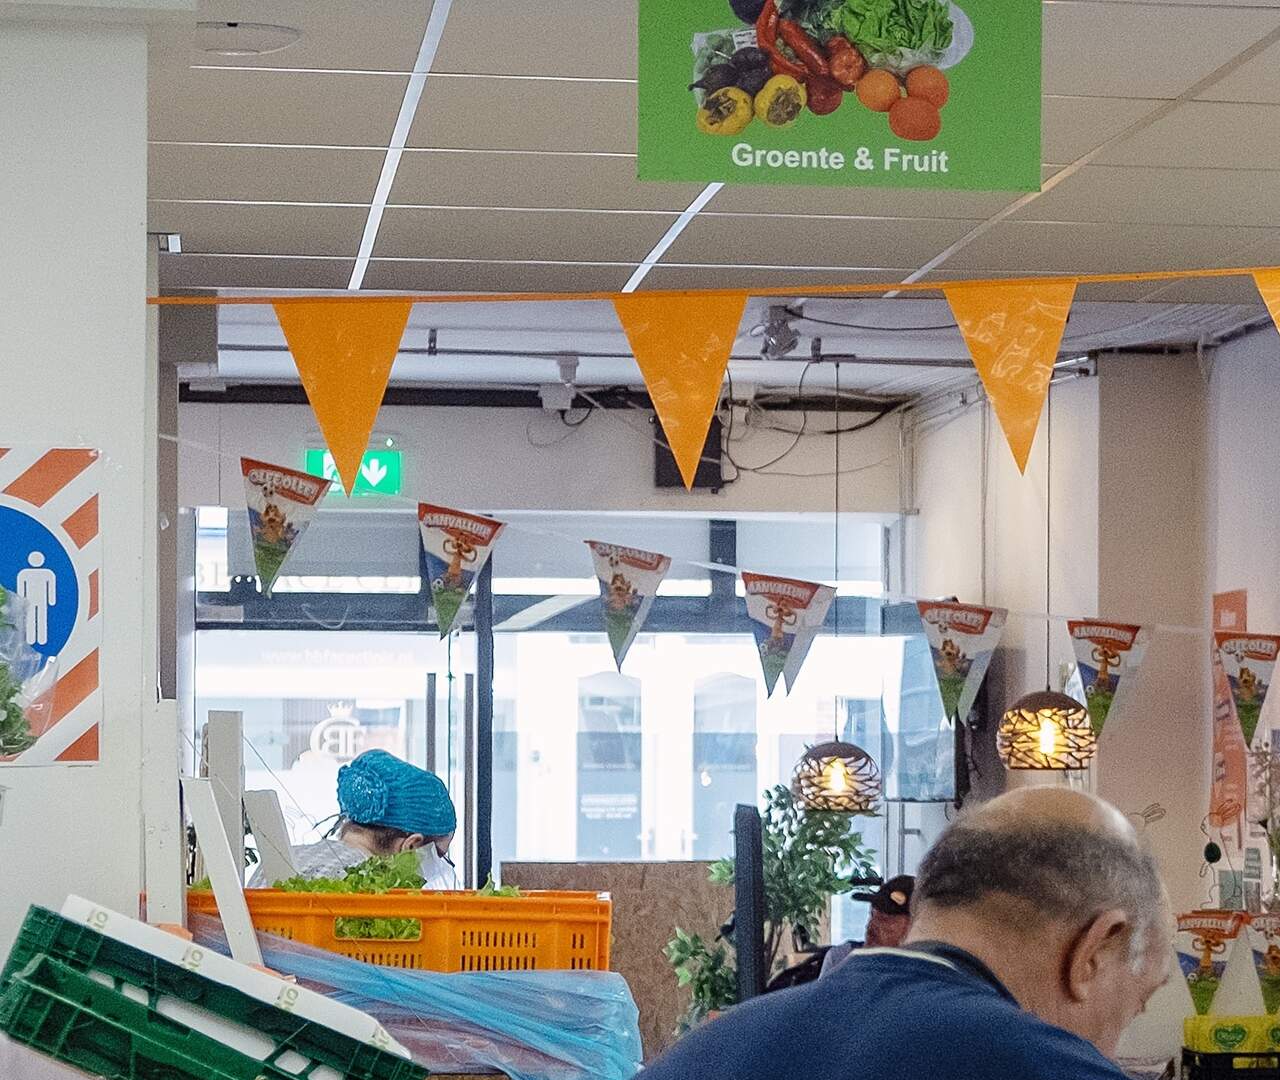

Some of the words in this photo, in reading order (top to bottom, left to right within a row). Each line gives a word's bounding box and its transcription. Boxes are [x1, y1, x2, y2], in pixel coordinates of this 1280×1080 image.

[731, 143, 845, 170] Groente
[854, 148, 874, 171] &
[884, 148, 949, 173] Fruit
